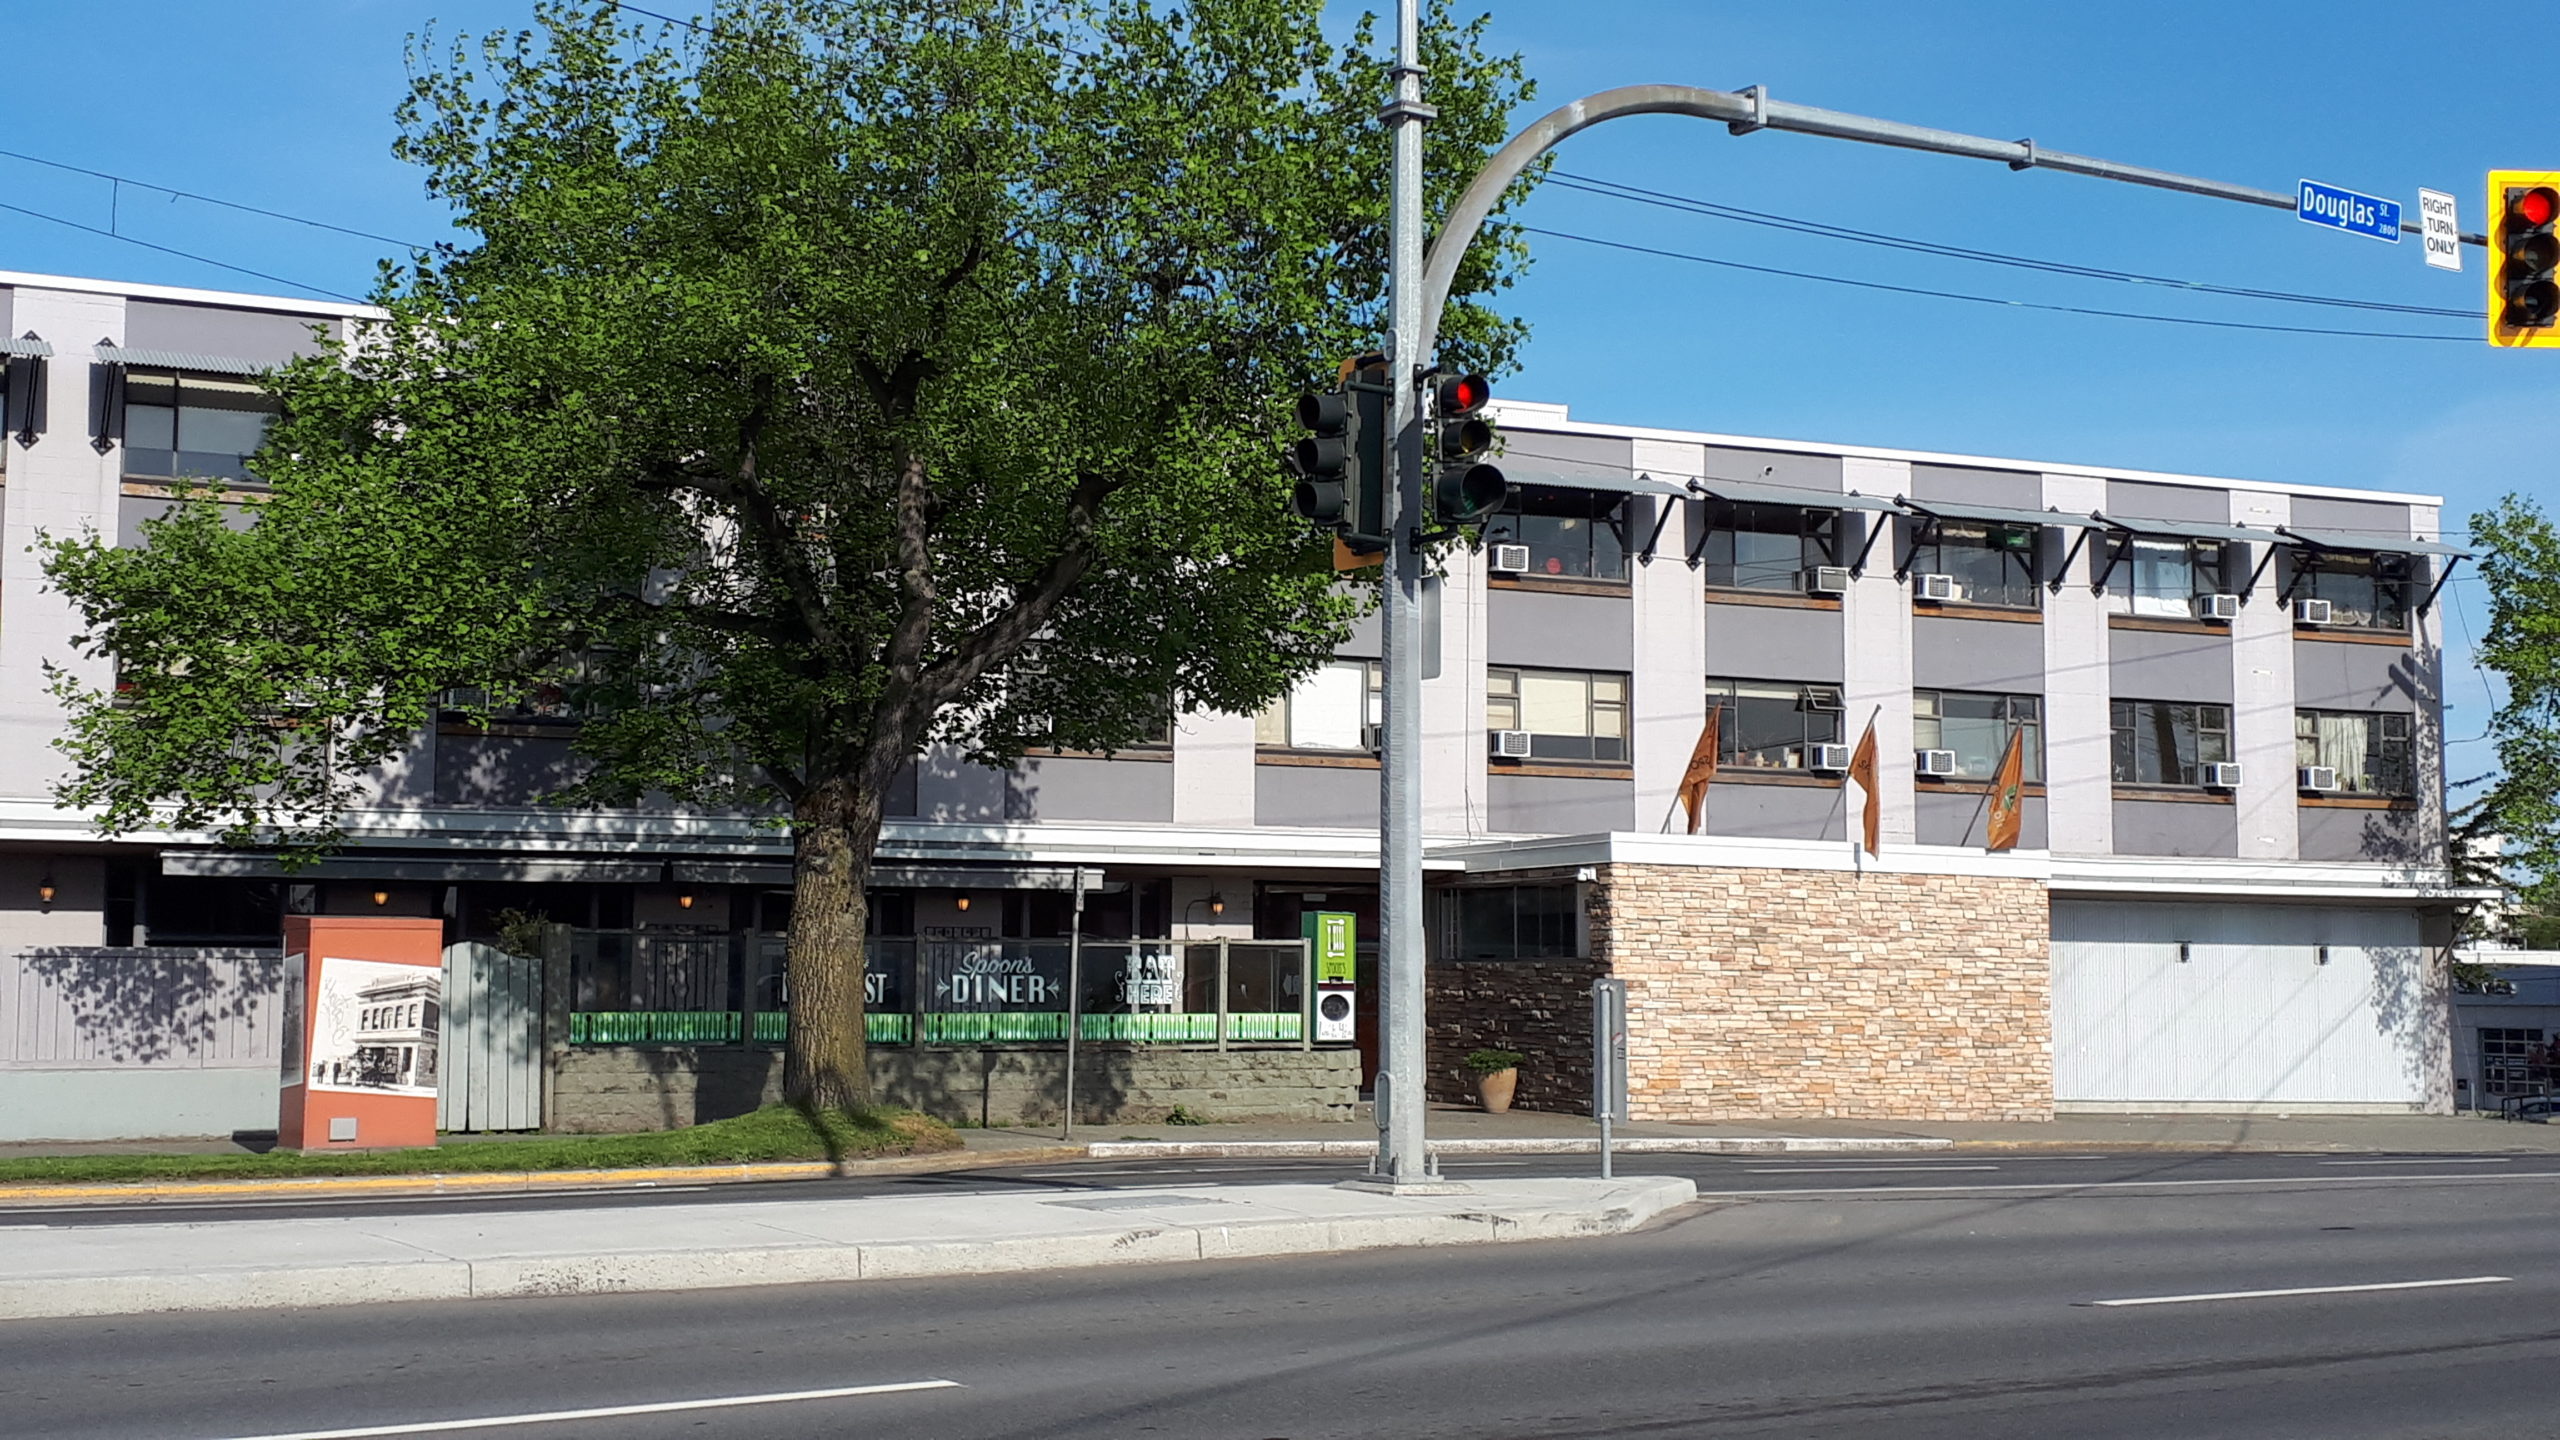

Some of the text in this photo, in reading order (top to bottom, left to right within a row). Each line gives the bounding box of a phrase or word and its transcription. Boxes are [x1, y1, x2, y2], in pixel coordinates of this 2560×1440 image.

[2303, 186, 2375, 227] Douglas
[2422, 197, 2453, 217] RIGHT
[2378, 225, 2397, 237] 2800
[2427, 217, 2454, 236] TURN
[2427, 237, 2455, 255] ONLY
[1125, 955, 1176, 984] EAT
[952, 974, 1045, 1003] DINER
[1126, 984, 1173, 1004] HERE
